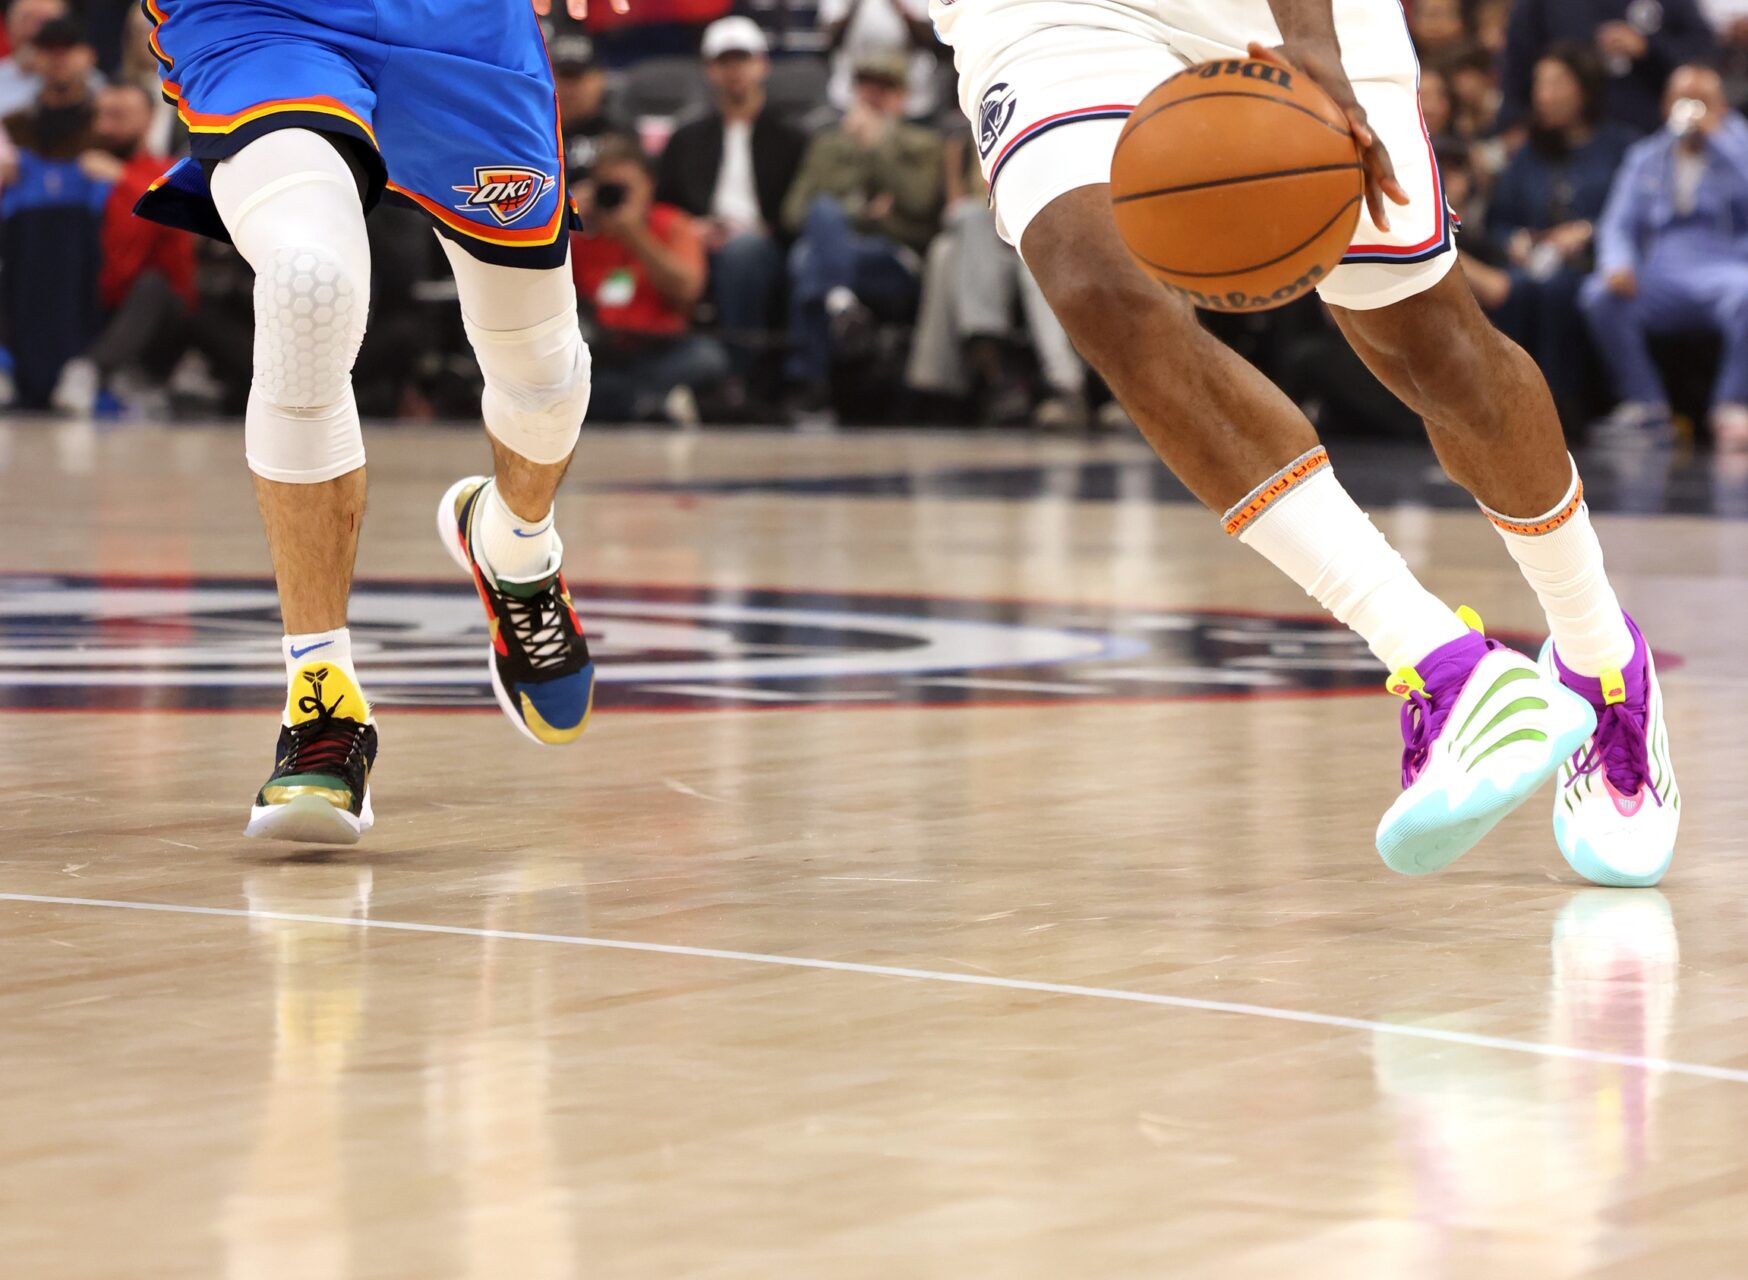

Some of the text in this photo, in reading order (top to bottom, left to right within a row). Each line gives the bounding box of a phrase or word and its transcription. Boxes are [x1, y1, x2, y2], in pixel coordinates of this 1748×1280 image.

[468, 178, 532, 204] OKC
[1226, 453, 1328, 535] NBA AUTHE
